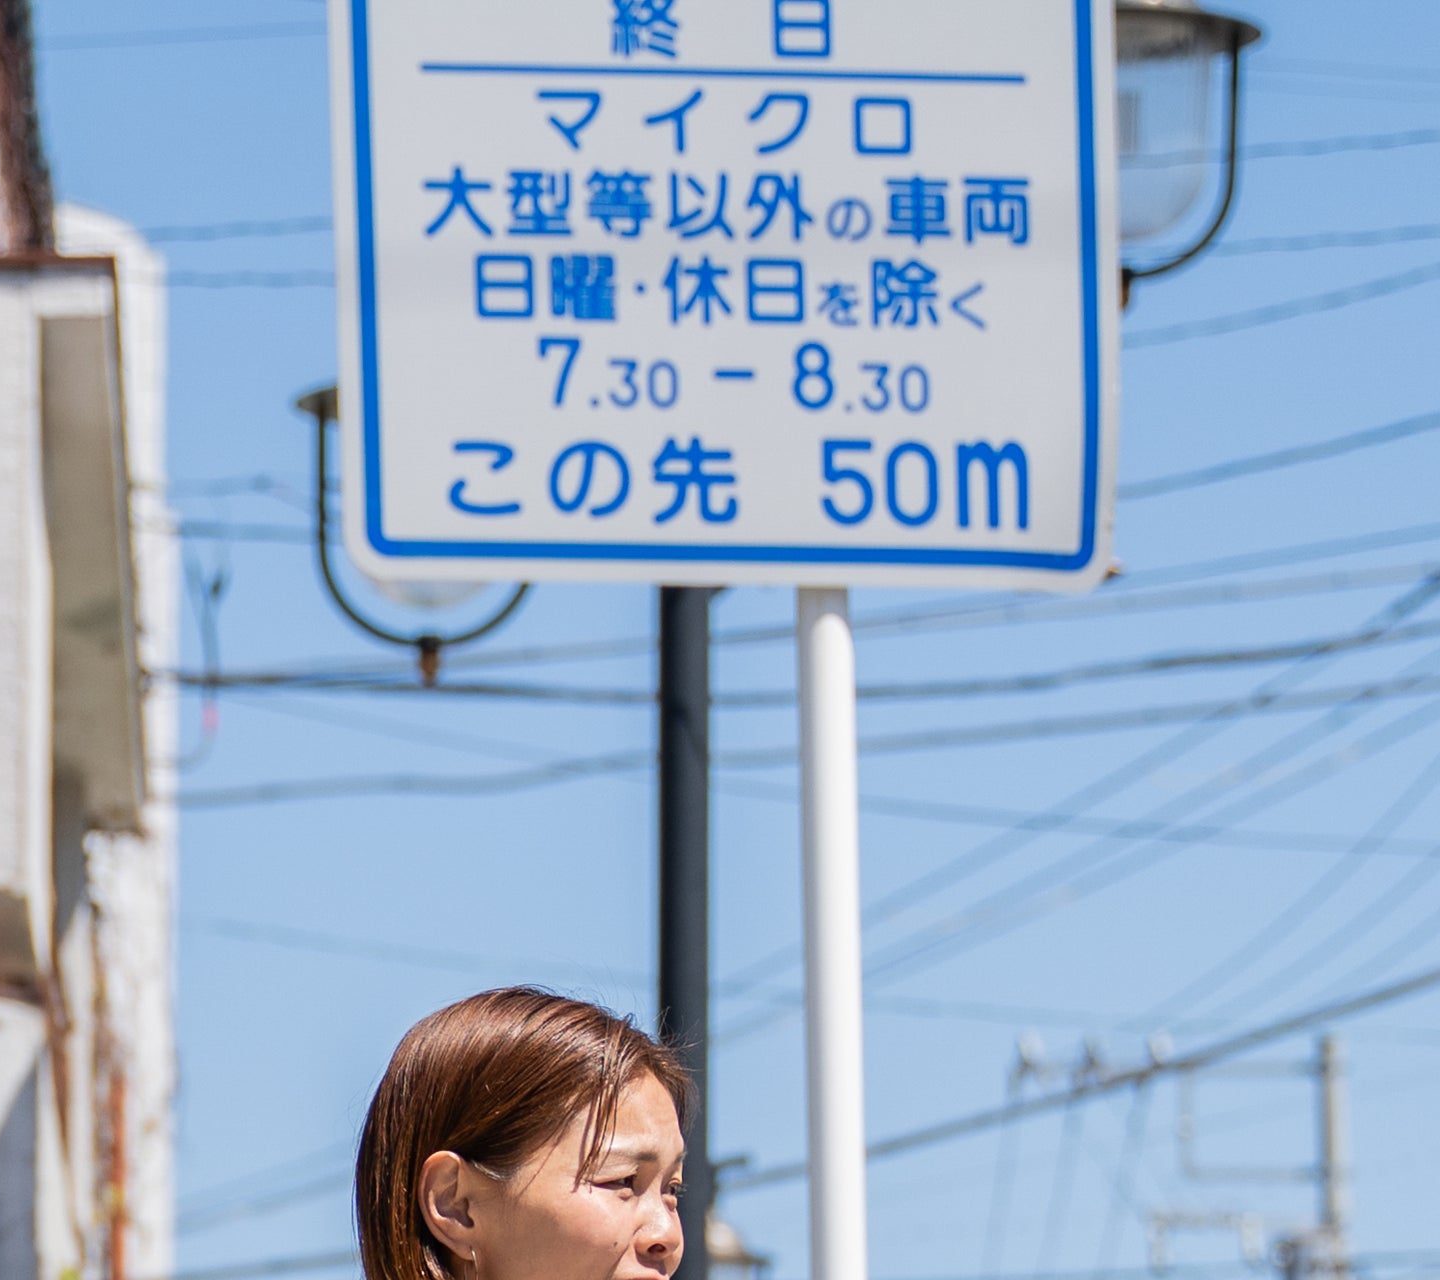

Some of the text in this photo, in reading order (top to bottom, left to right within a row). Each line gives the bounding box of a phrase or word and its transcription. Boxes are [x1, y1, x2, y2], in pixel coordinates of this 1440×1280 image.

[535, 88, 915, 158] マイクロ
[421, 165, 1032, 247] 大型等以外の車両
[446, 436, 1032, 532] この先 50m
